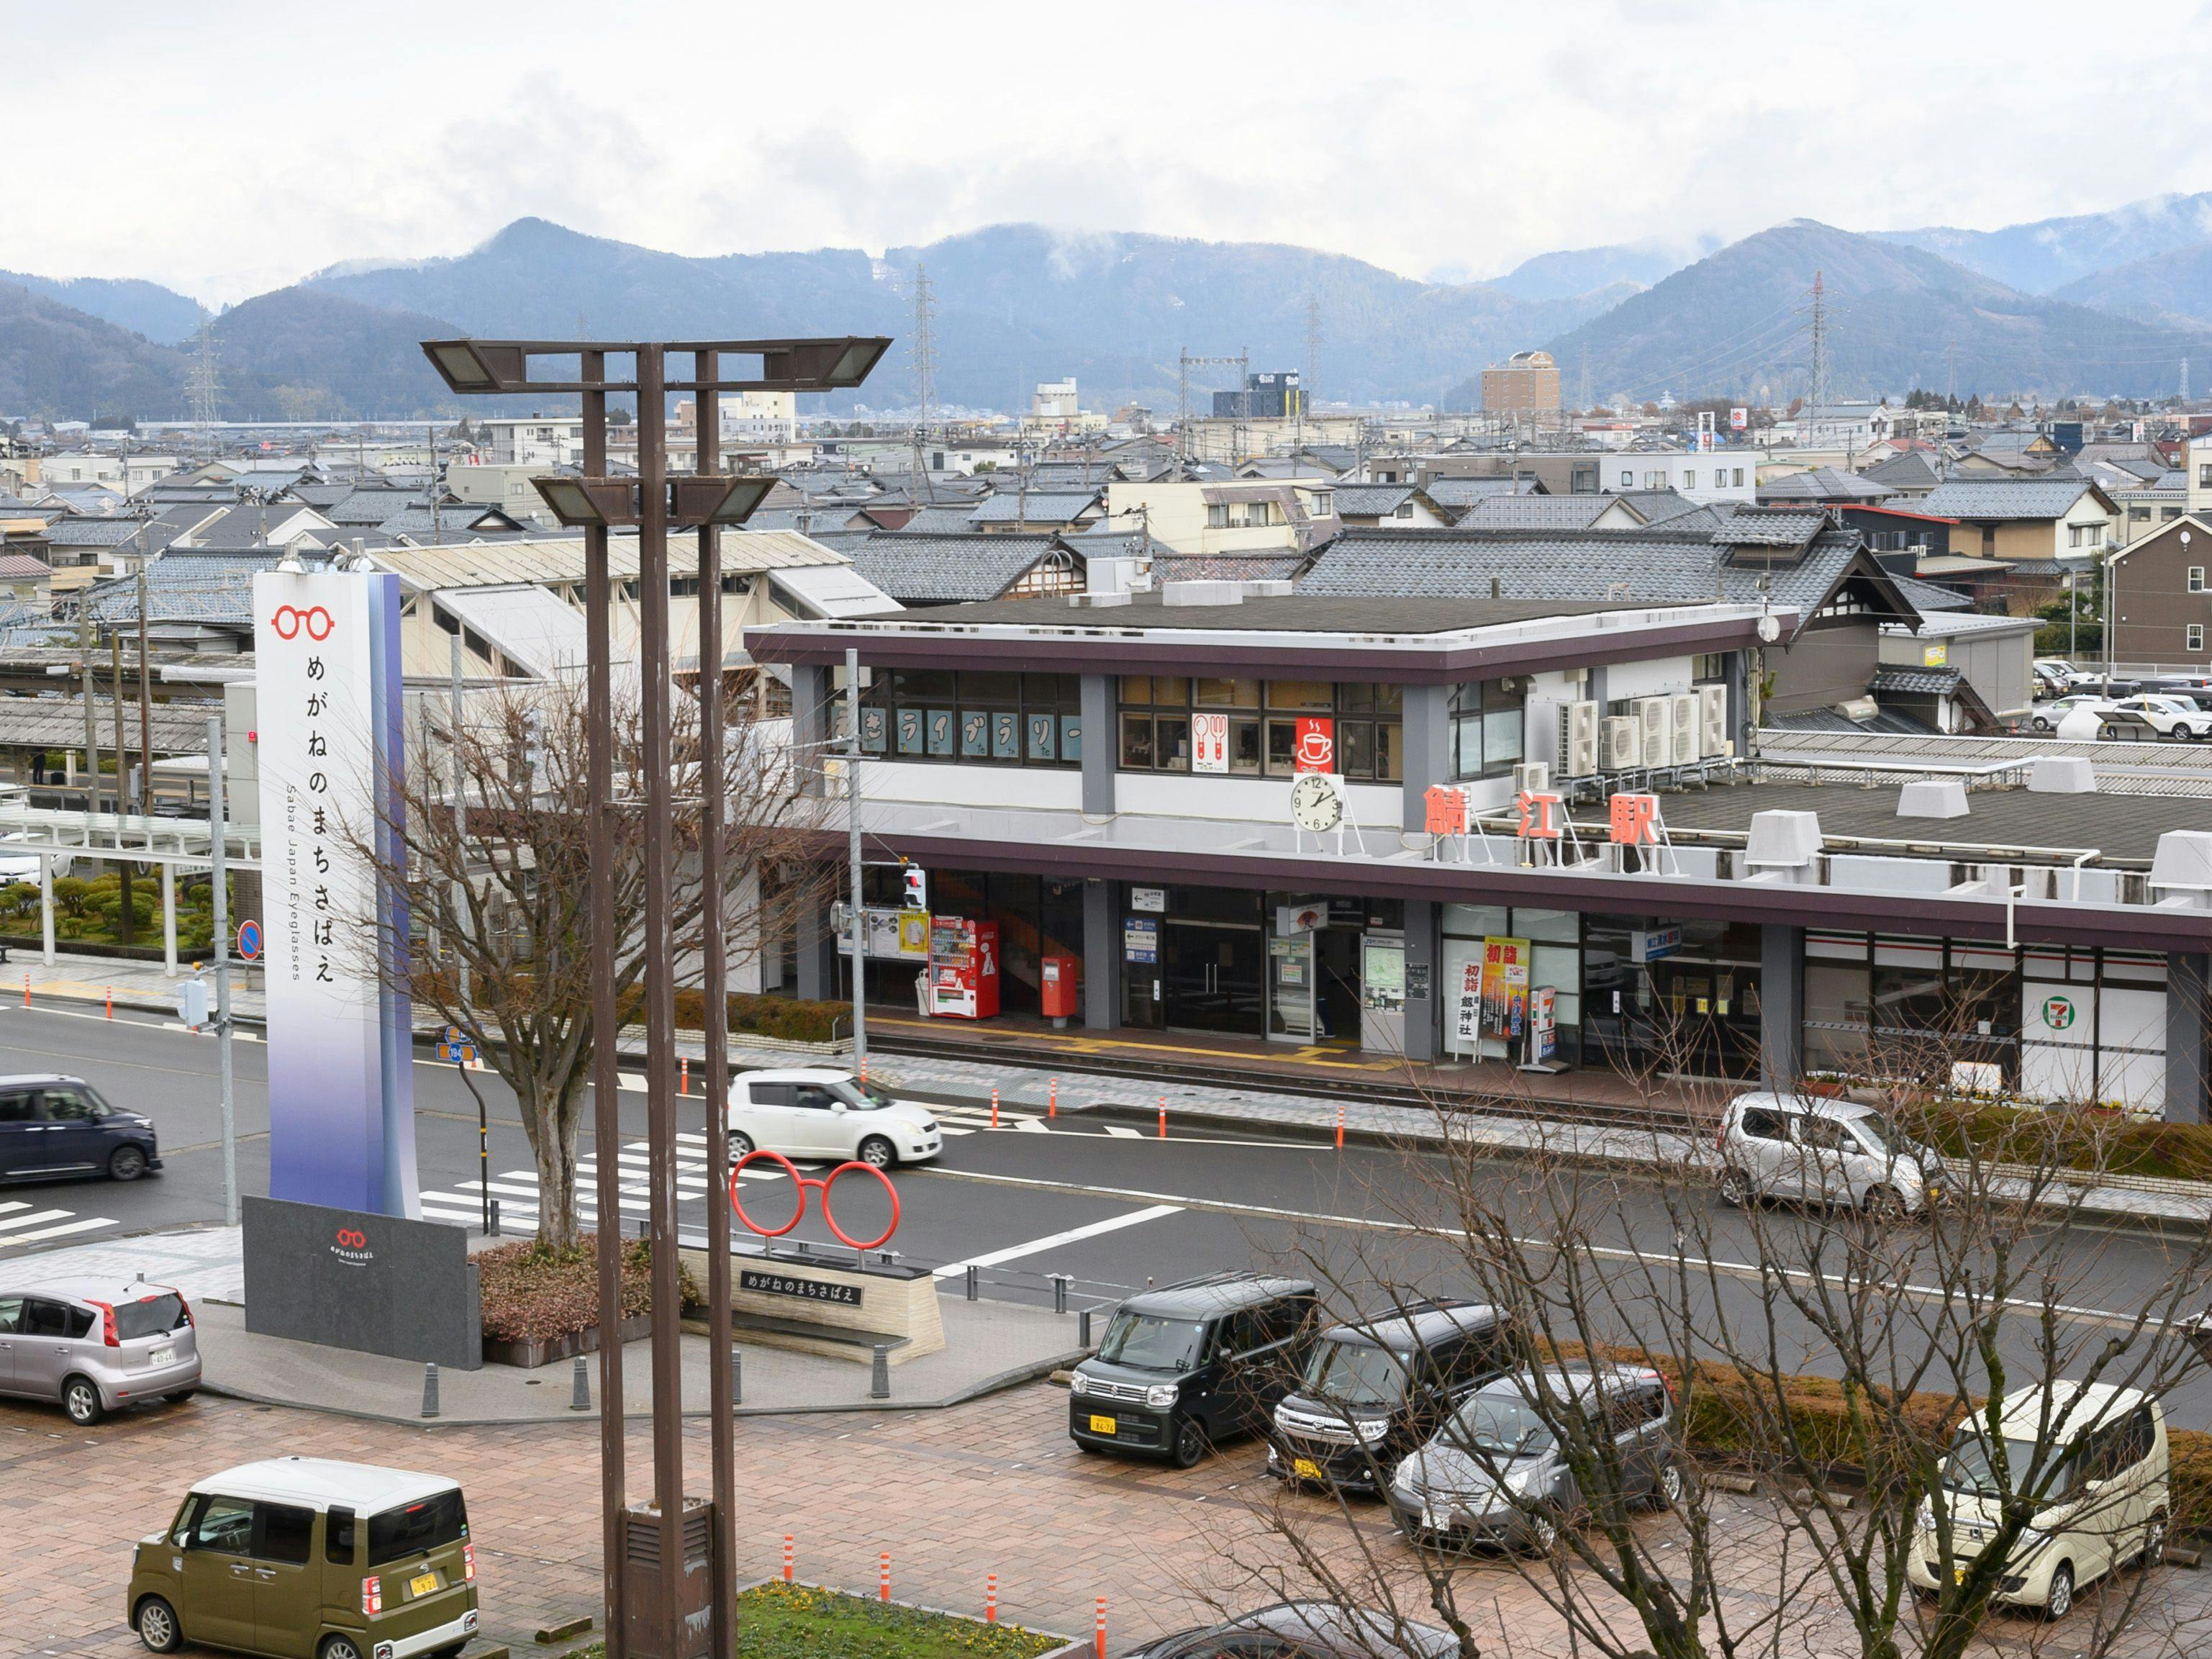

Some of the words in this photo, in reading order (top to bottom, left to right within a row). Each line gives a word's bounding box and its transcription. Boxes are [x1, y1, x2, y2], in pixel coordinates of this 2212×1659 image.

[1311, 778, 1321, 789] 12
[287, 785, 297, 832] Sabae
[1295, 798, 1301, 808] 9
[1332, 799, 1338, 810] 3
[1424, 785, 1661, 845] 鯖江駅
[307, 656, 333, 982] めがねのまちさばえ
[1313, 818, 1320, 829] 6
[287, 840, 298, 885] Japan
[289, 893, 299, 981] Eyeglasses
[1464, 964, 1480, 993] 初詣
[450, 1047, 461, 1057] 194
[748, 1275, 853, 1301] めがねのまちさばえ
